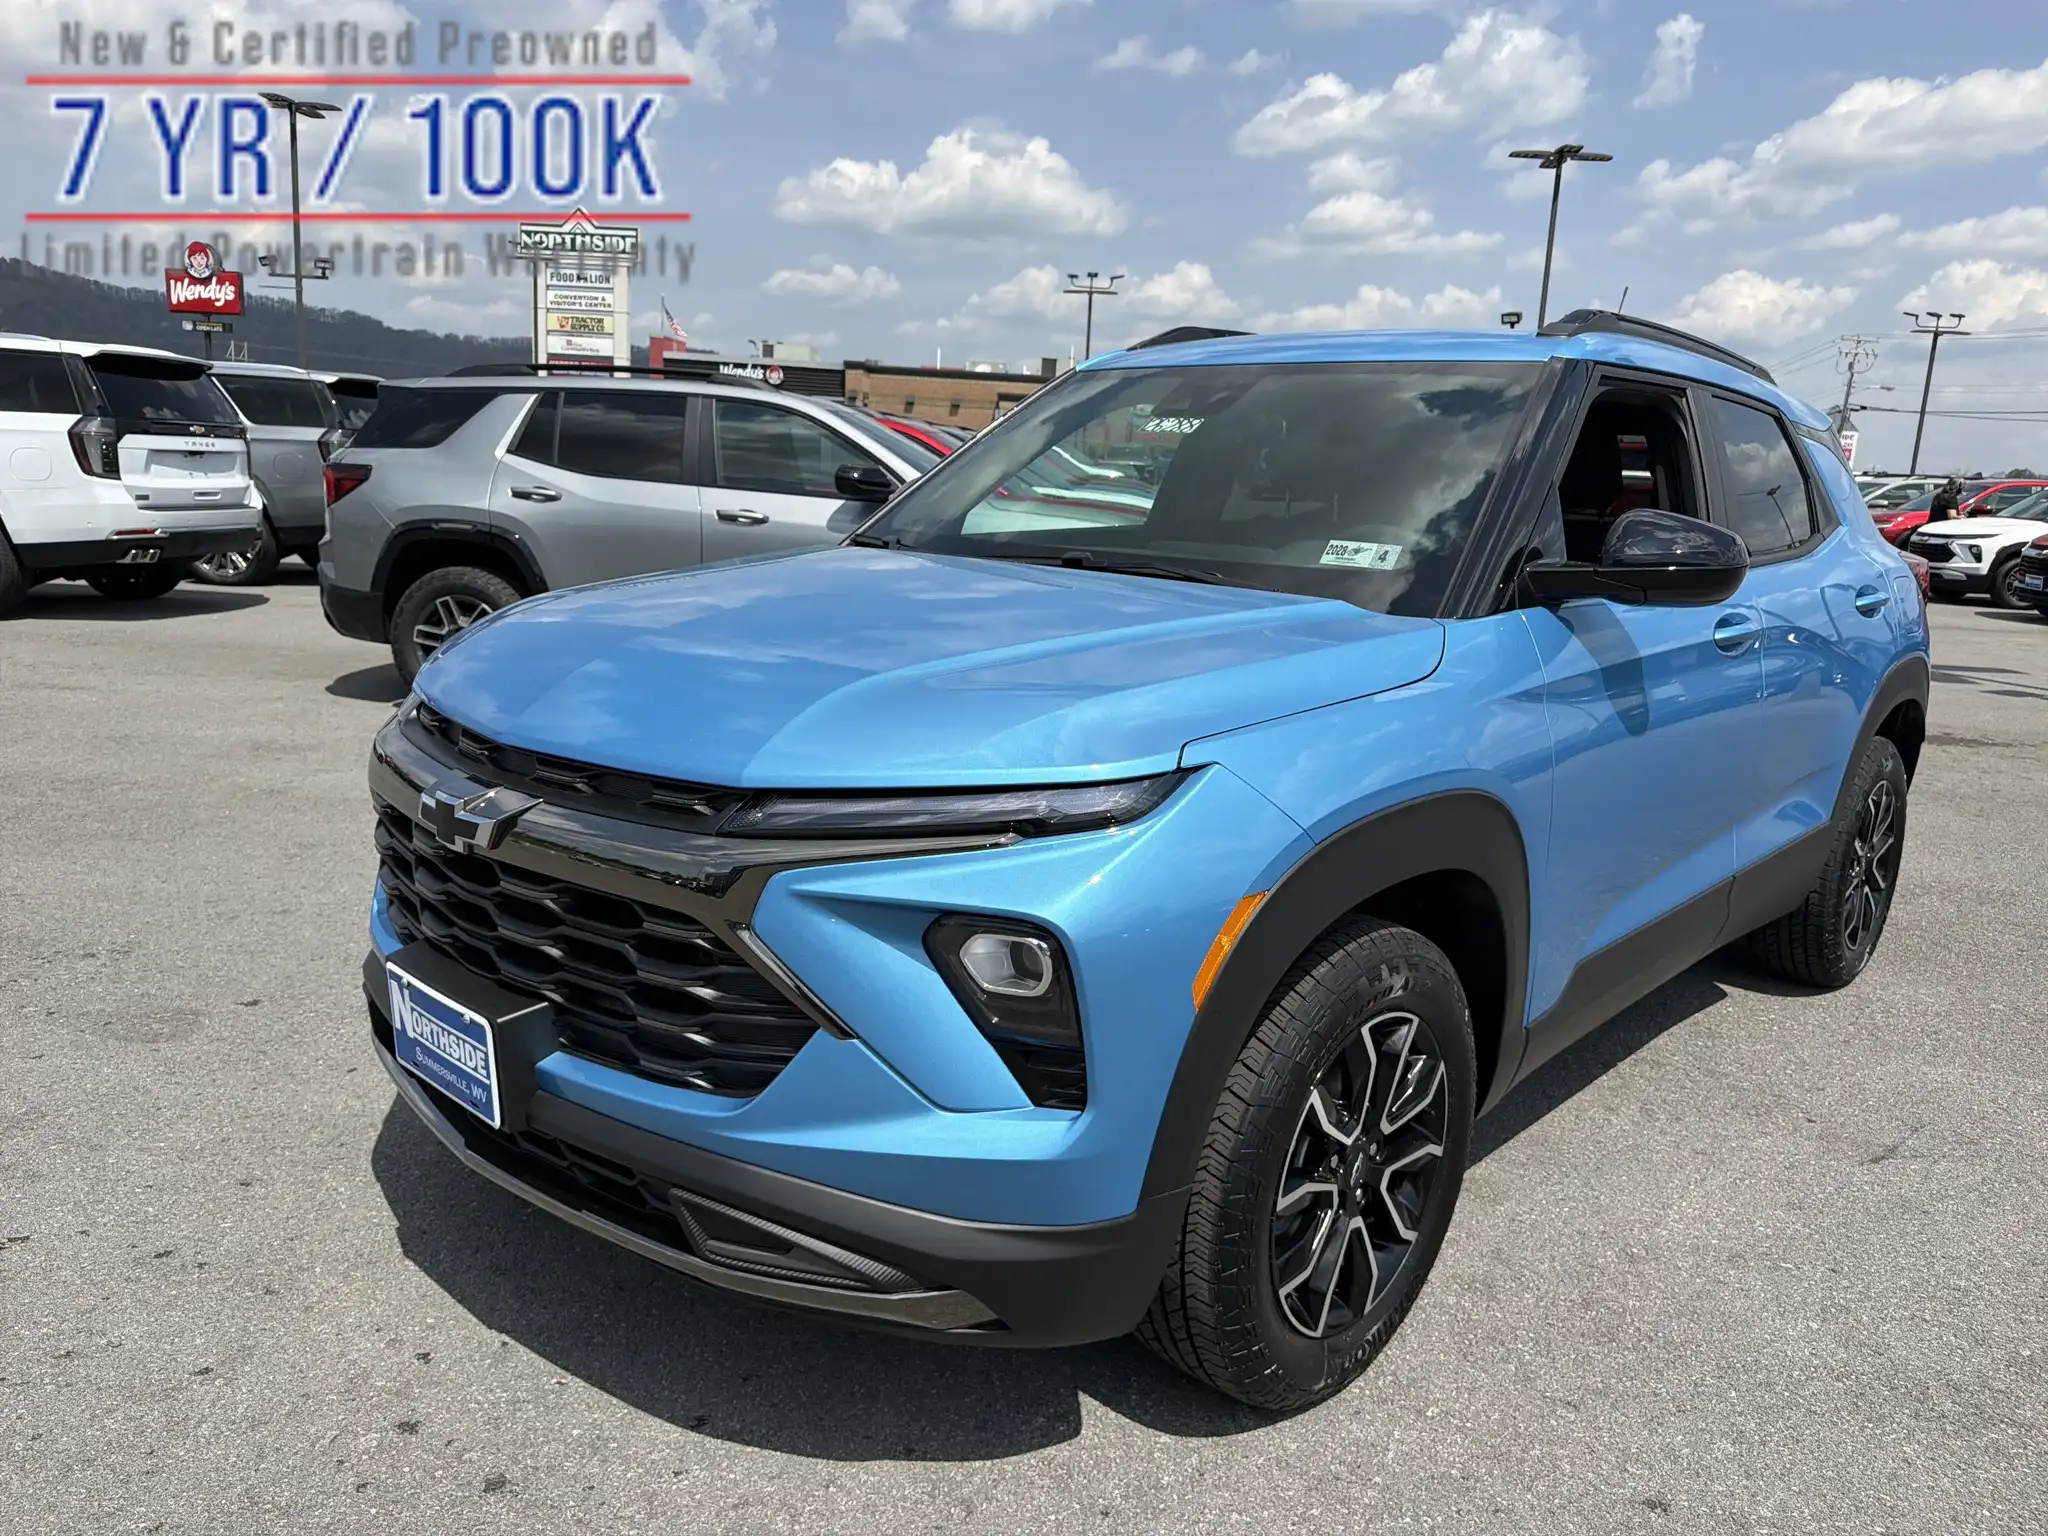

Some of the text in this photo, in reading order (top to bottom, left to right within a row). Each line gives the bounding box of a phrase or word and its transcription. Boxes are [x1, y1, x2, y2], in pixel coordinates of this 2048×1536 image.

[520, 232, 637, 253] NORTHSIDE
[550, 272, 611, 285] FOOD LION
[169, 275, 236, 307] Wendy's
[553, 293, 600, 302] CONVENTION
[719, 361, 765, 380] Wendy's
[1325, 544, 1390, 563] 2028 4
[390, 979, 488, 1077] NORTHSIDE
[471, 1083, 488, 1103] WV
